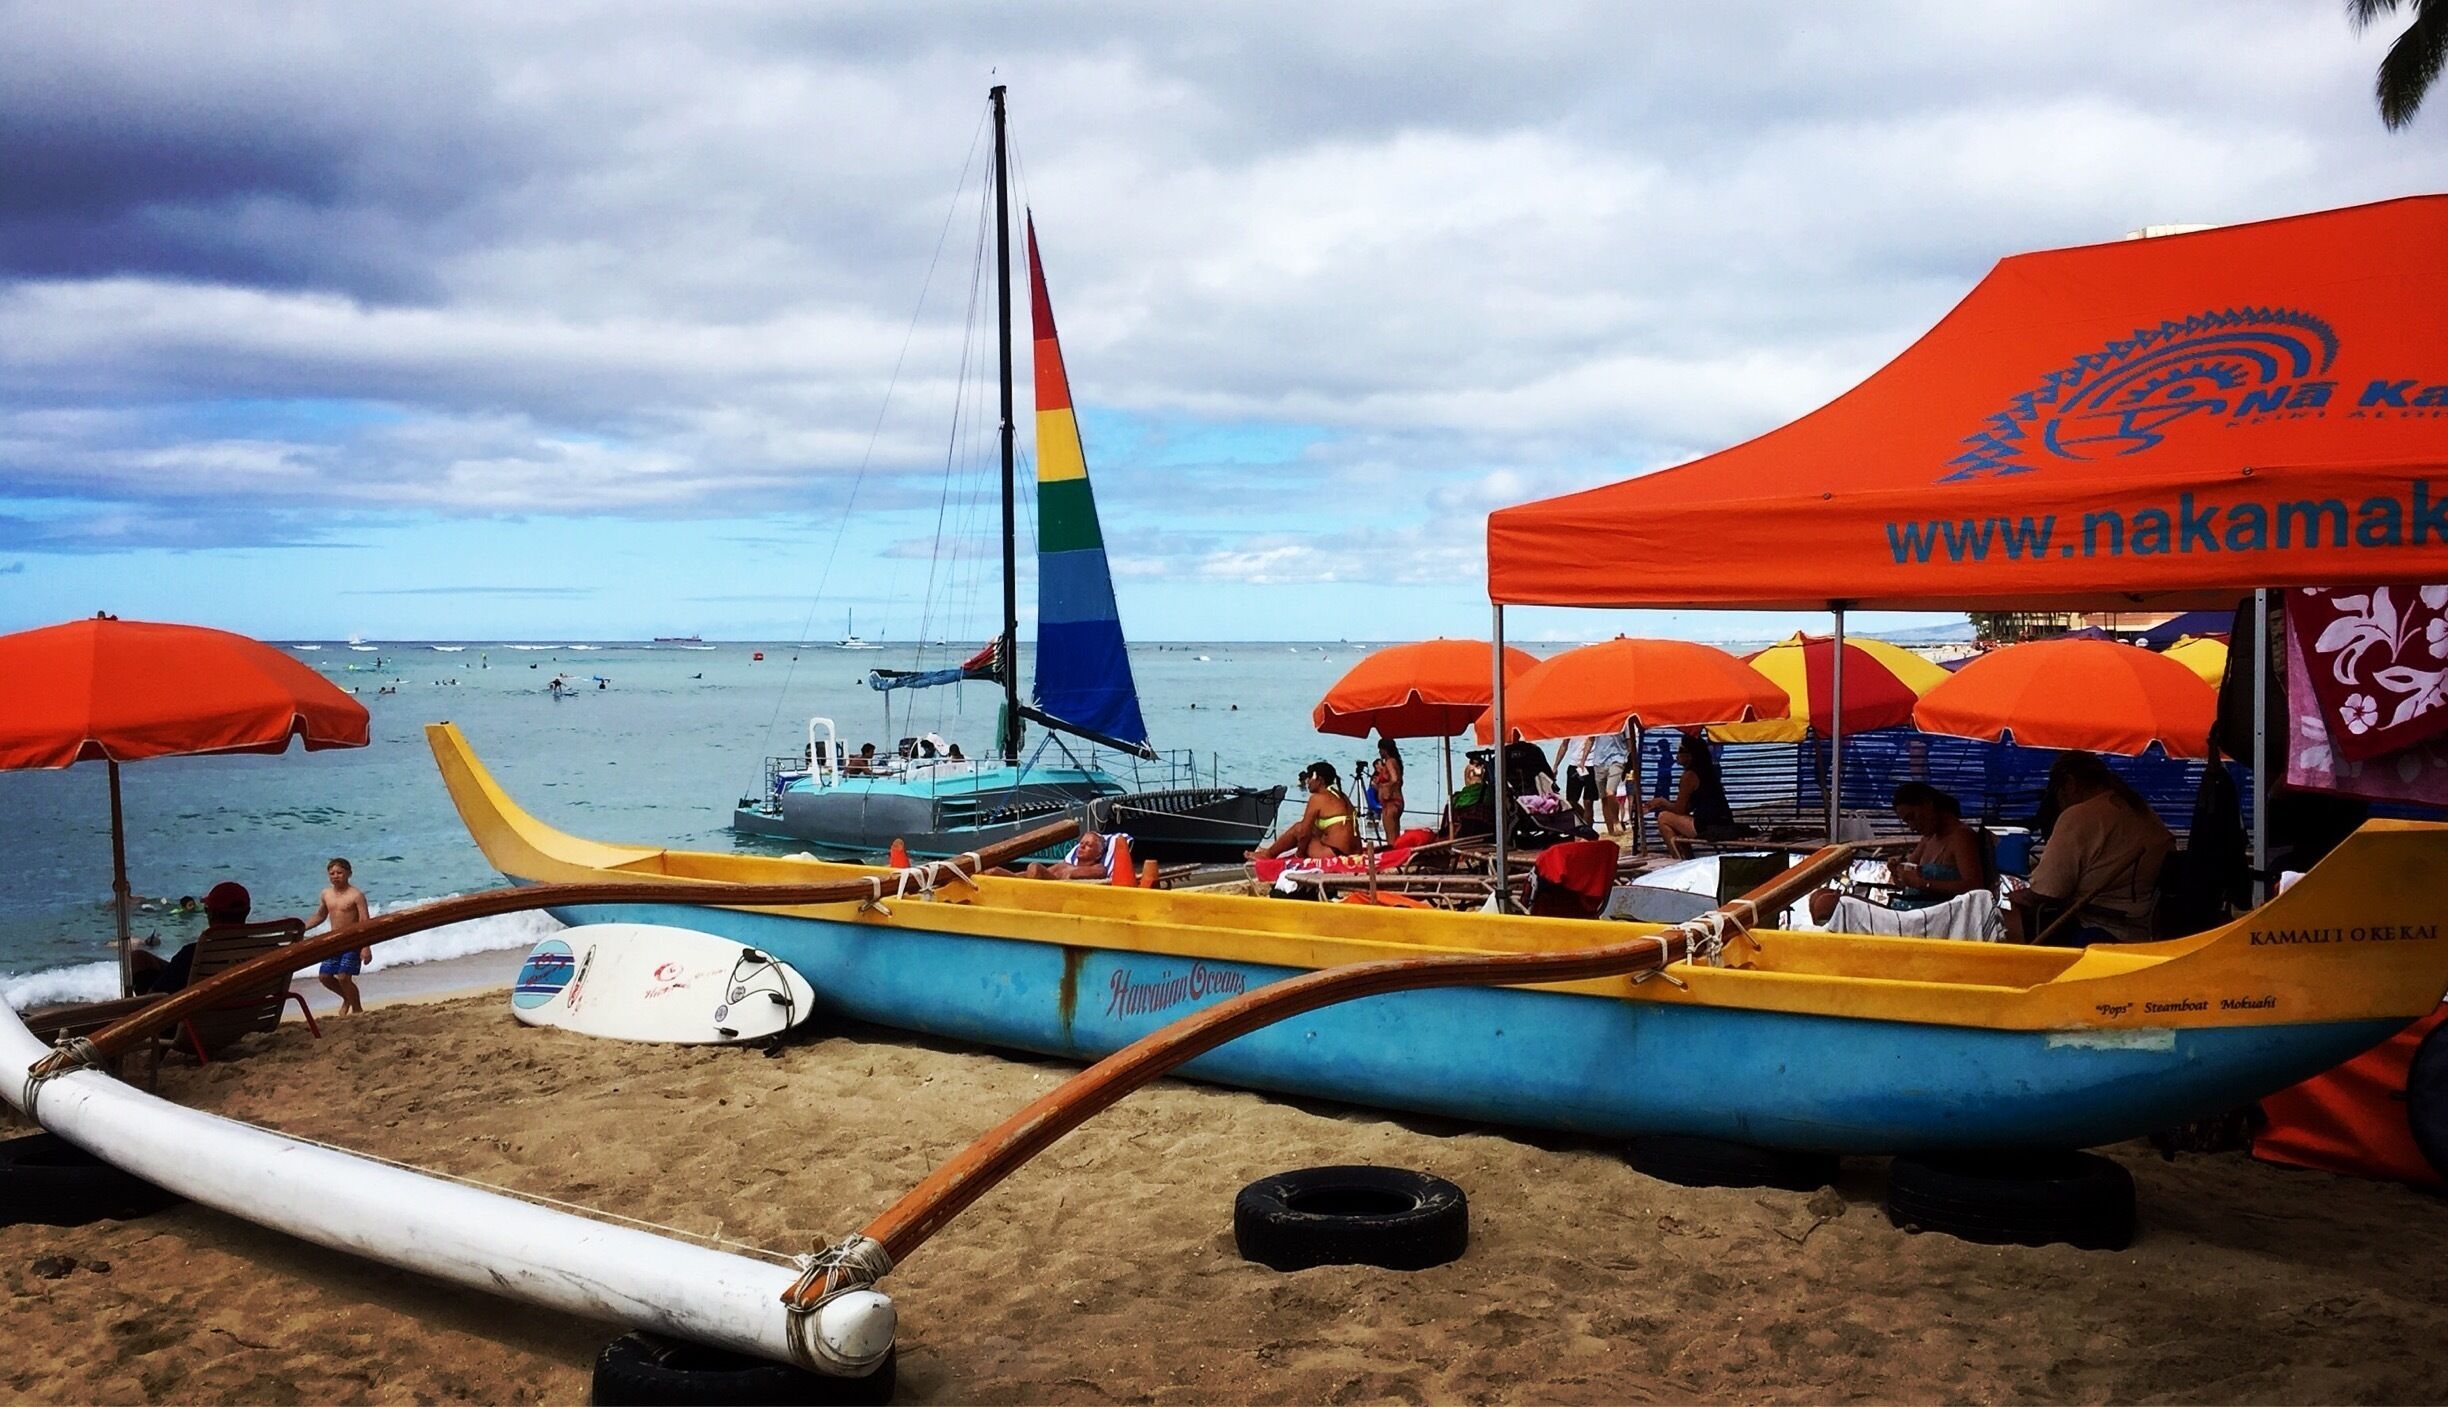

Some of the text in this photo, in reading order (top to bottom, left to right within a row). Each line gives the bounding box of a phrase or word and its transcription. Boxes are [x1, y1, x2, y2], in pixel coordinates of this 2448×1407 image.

[1885, 479, 2448, 564] www.nakamak
[2400, 924, 2439, 940] KAI
[1106, 961, 1246, 1021] Hawaiian Oceans
[2144, 998, 2209, 1014] Steamboat
[2220, 995, 2278, 1010] Mokuahi
